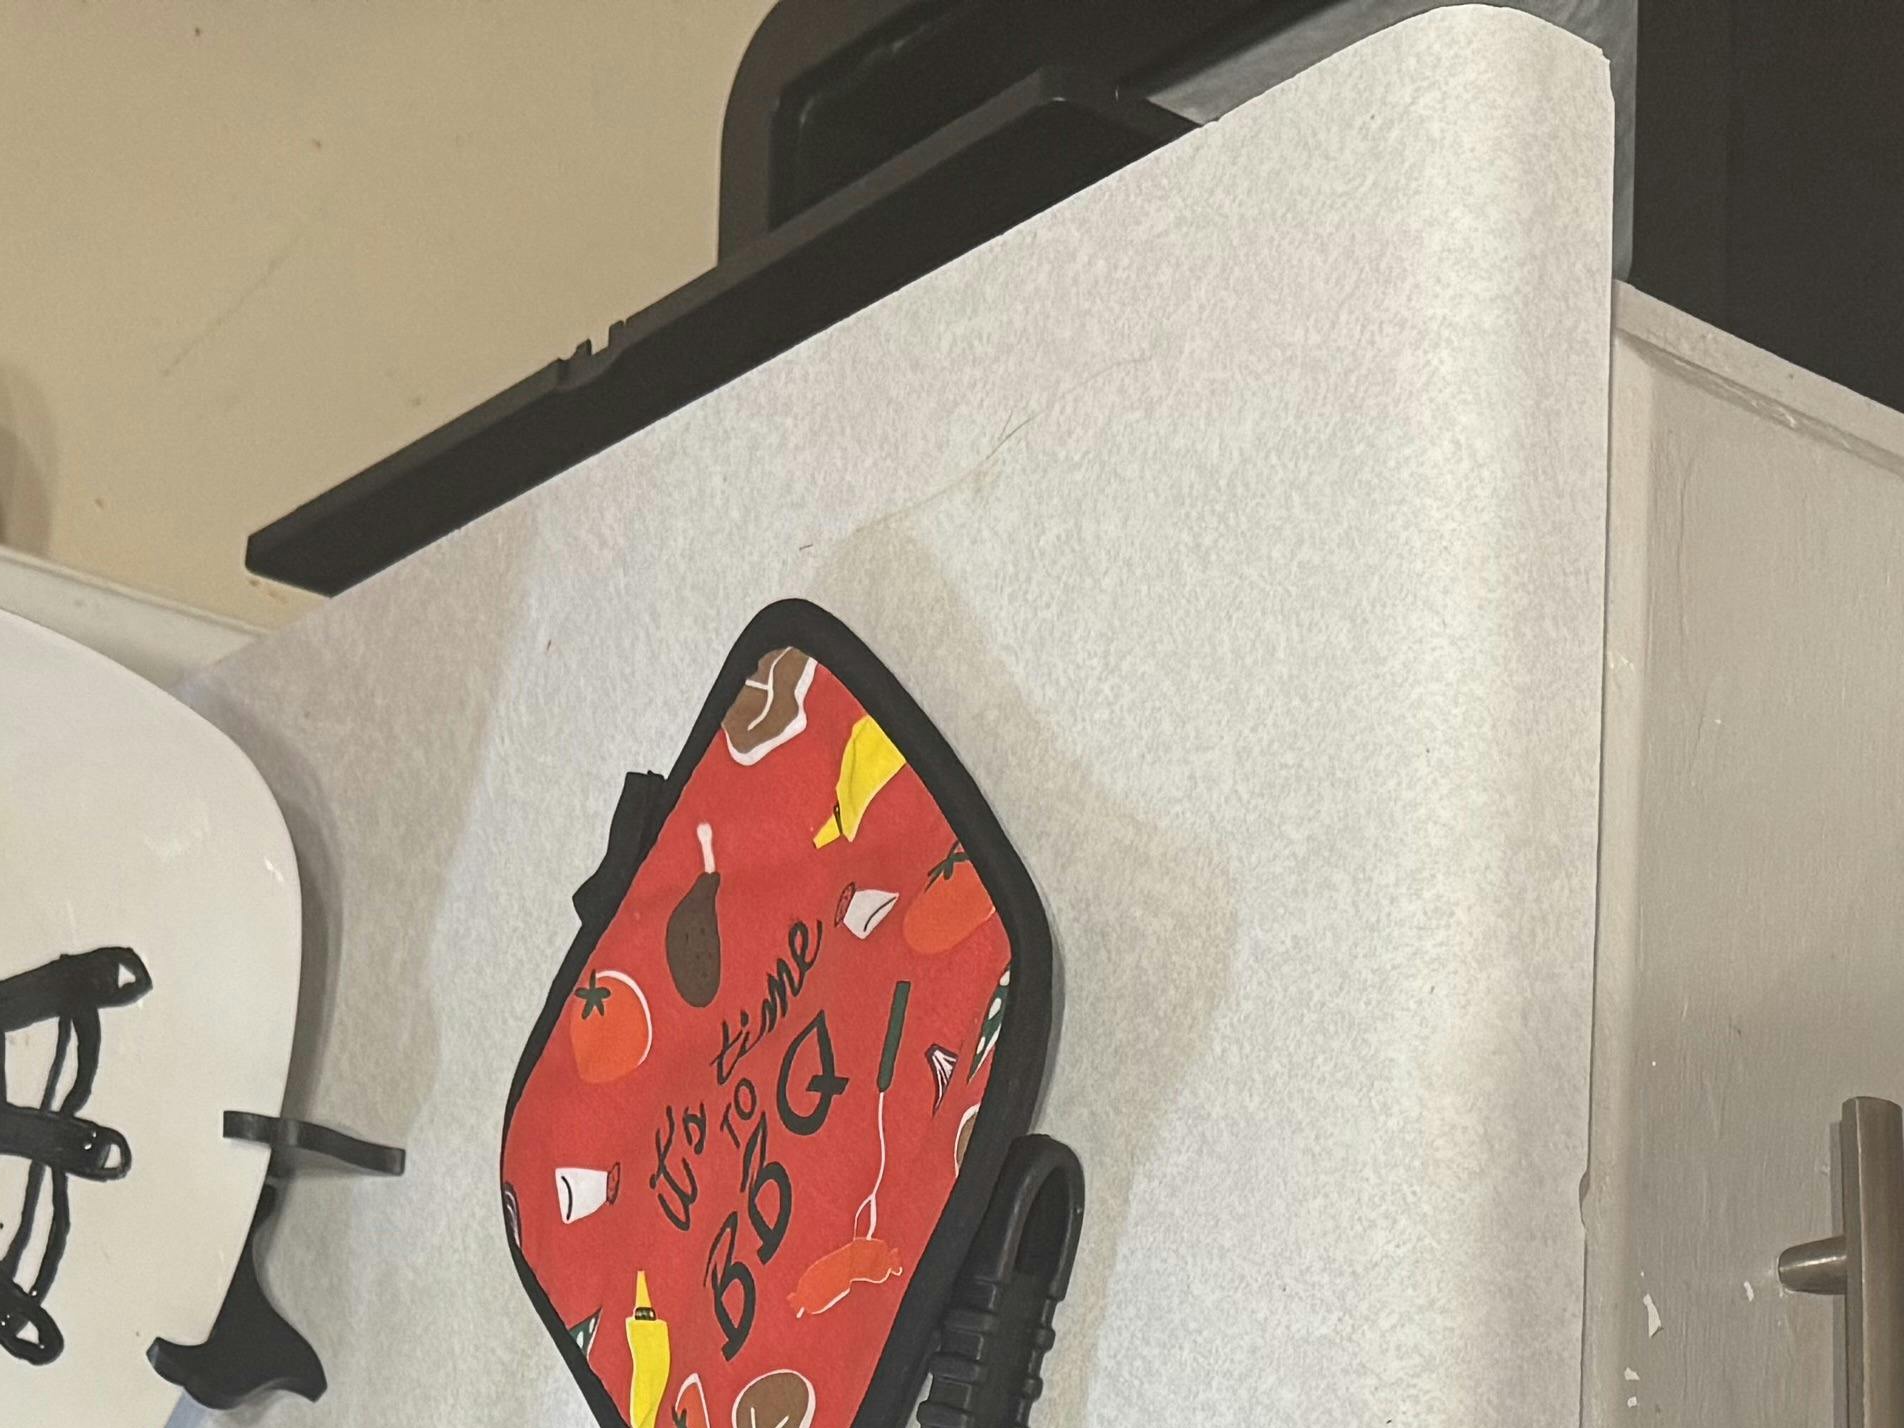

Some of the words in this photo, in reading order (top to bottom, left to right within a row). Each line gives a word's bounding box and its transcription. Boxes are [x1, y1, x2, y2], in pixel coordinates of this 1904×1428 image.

[649, 1102, 706, 1231] it's
[711, 919, 823, 1085] time
[704, 1009, 849, 1361] BBQ
[720, 1077, 757, 1149] TO
